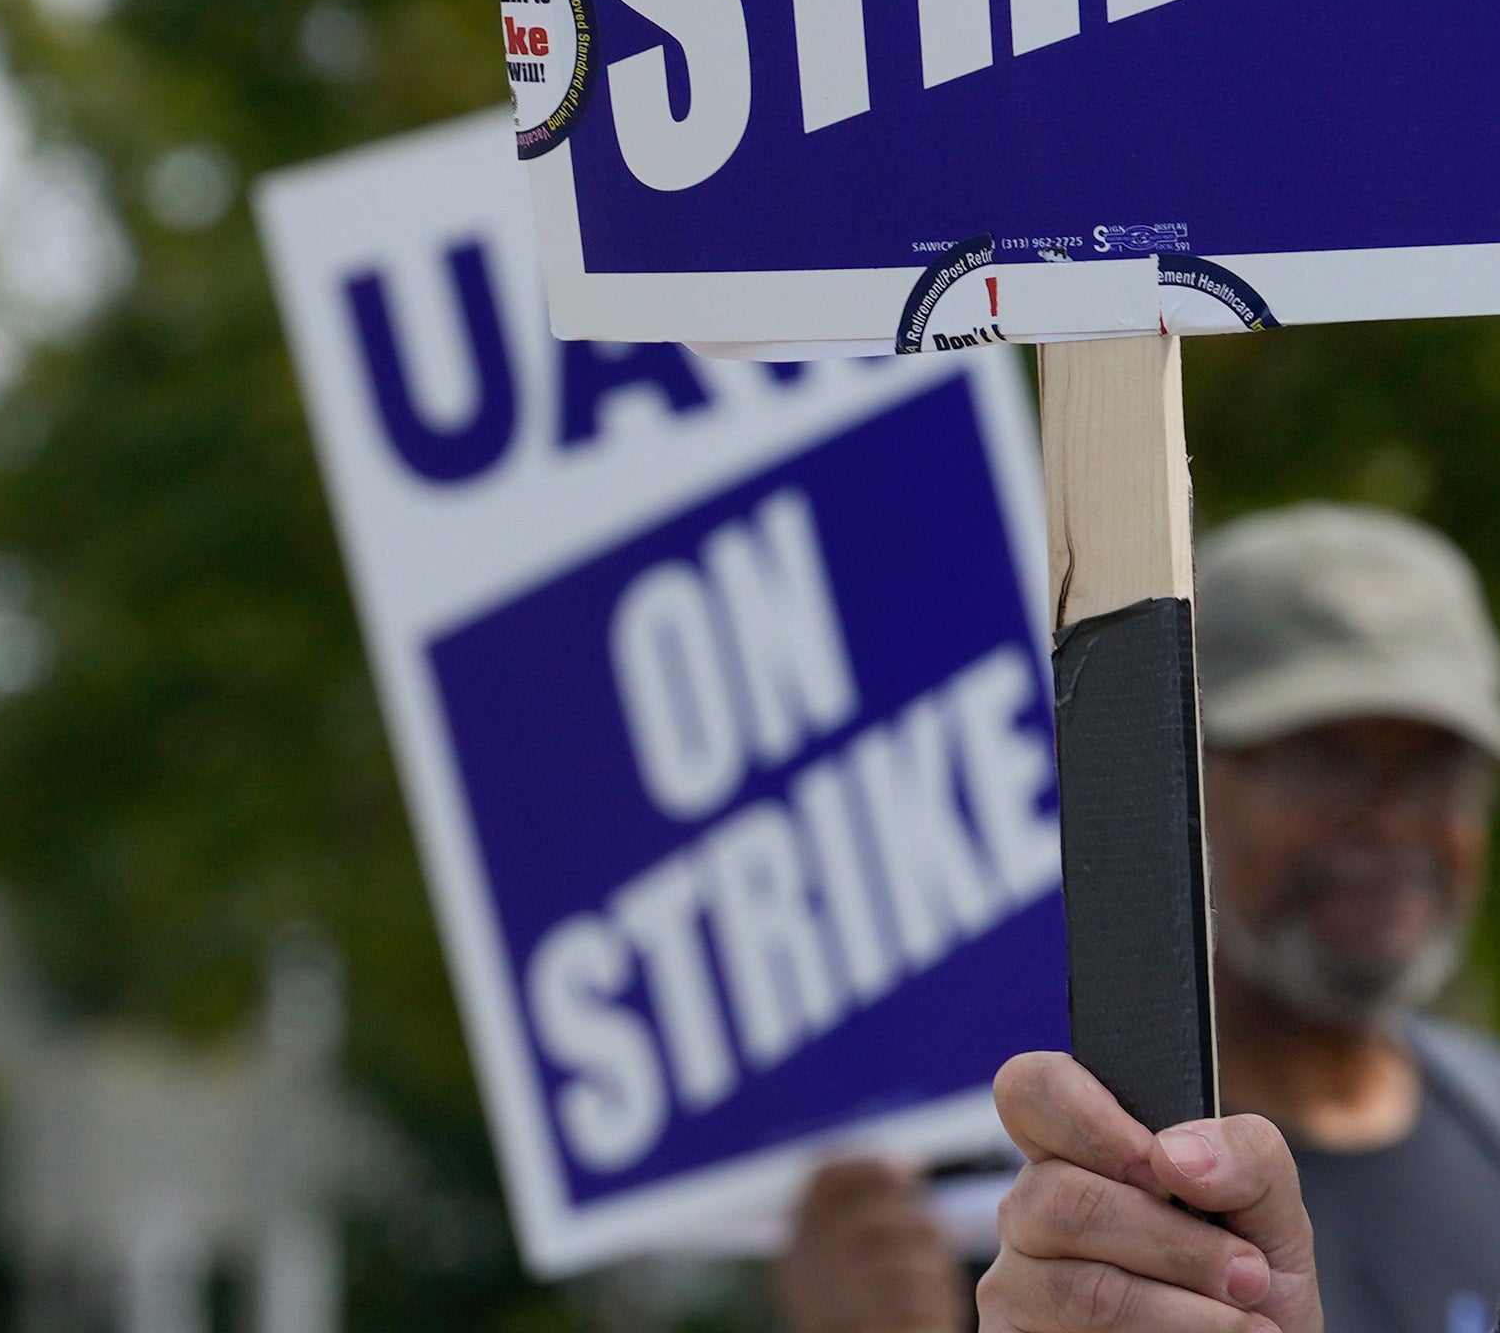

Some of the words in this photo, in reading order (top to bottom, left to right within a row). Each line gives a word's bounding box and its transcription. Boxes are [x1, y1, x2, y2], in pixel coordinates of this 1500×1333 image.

[506, 61, 546, 83] Will!
[572, 33, 590, 91] Standard
[546, 100, 575, 131] Living
[1001, 237, 1029, 251] (313)
[1197, 272, 1255, 322] Healthcare
[932, 326, 994, 351] Don't
[608, 486, 859, 822] ON
[525, 644, 1063, 1172] STRIKE
